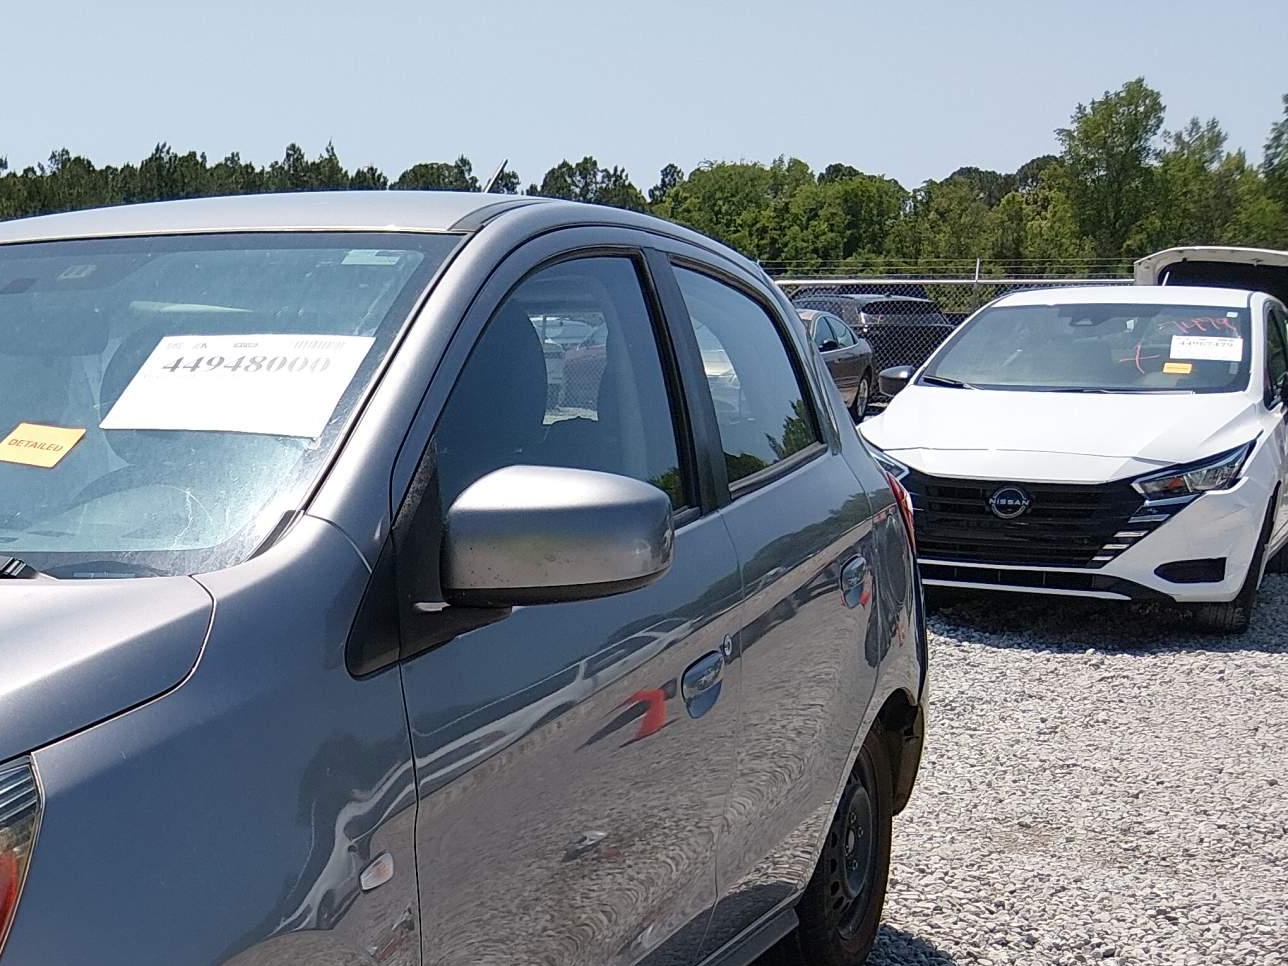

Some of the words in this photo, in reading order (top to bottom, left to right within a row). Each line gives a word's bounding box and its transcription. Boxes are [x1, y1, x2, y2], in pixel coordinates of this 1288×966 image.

[161, 355, 332, 373] 44948000
[7, 438, 64, 453] DETAILED
[988, 497, 1030, 506] NISSAN
